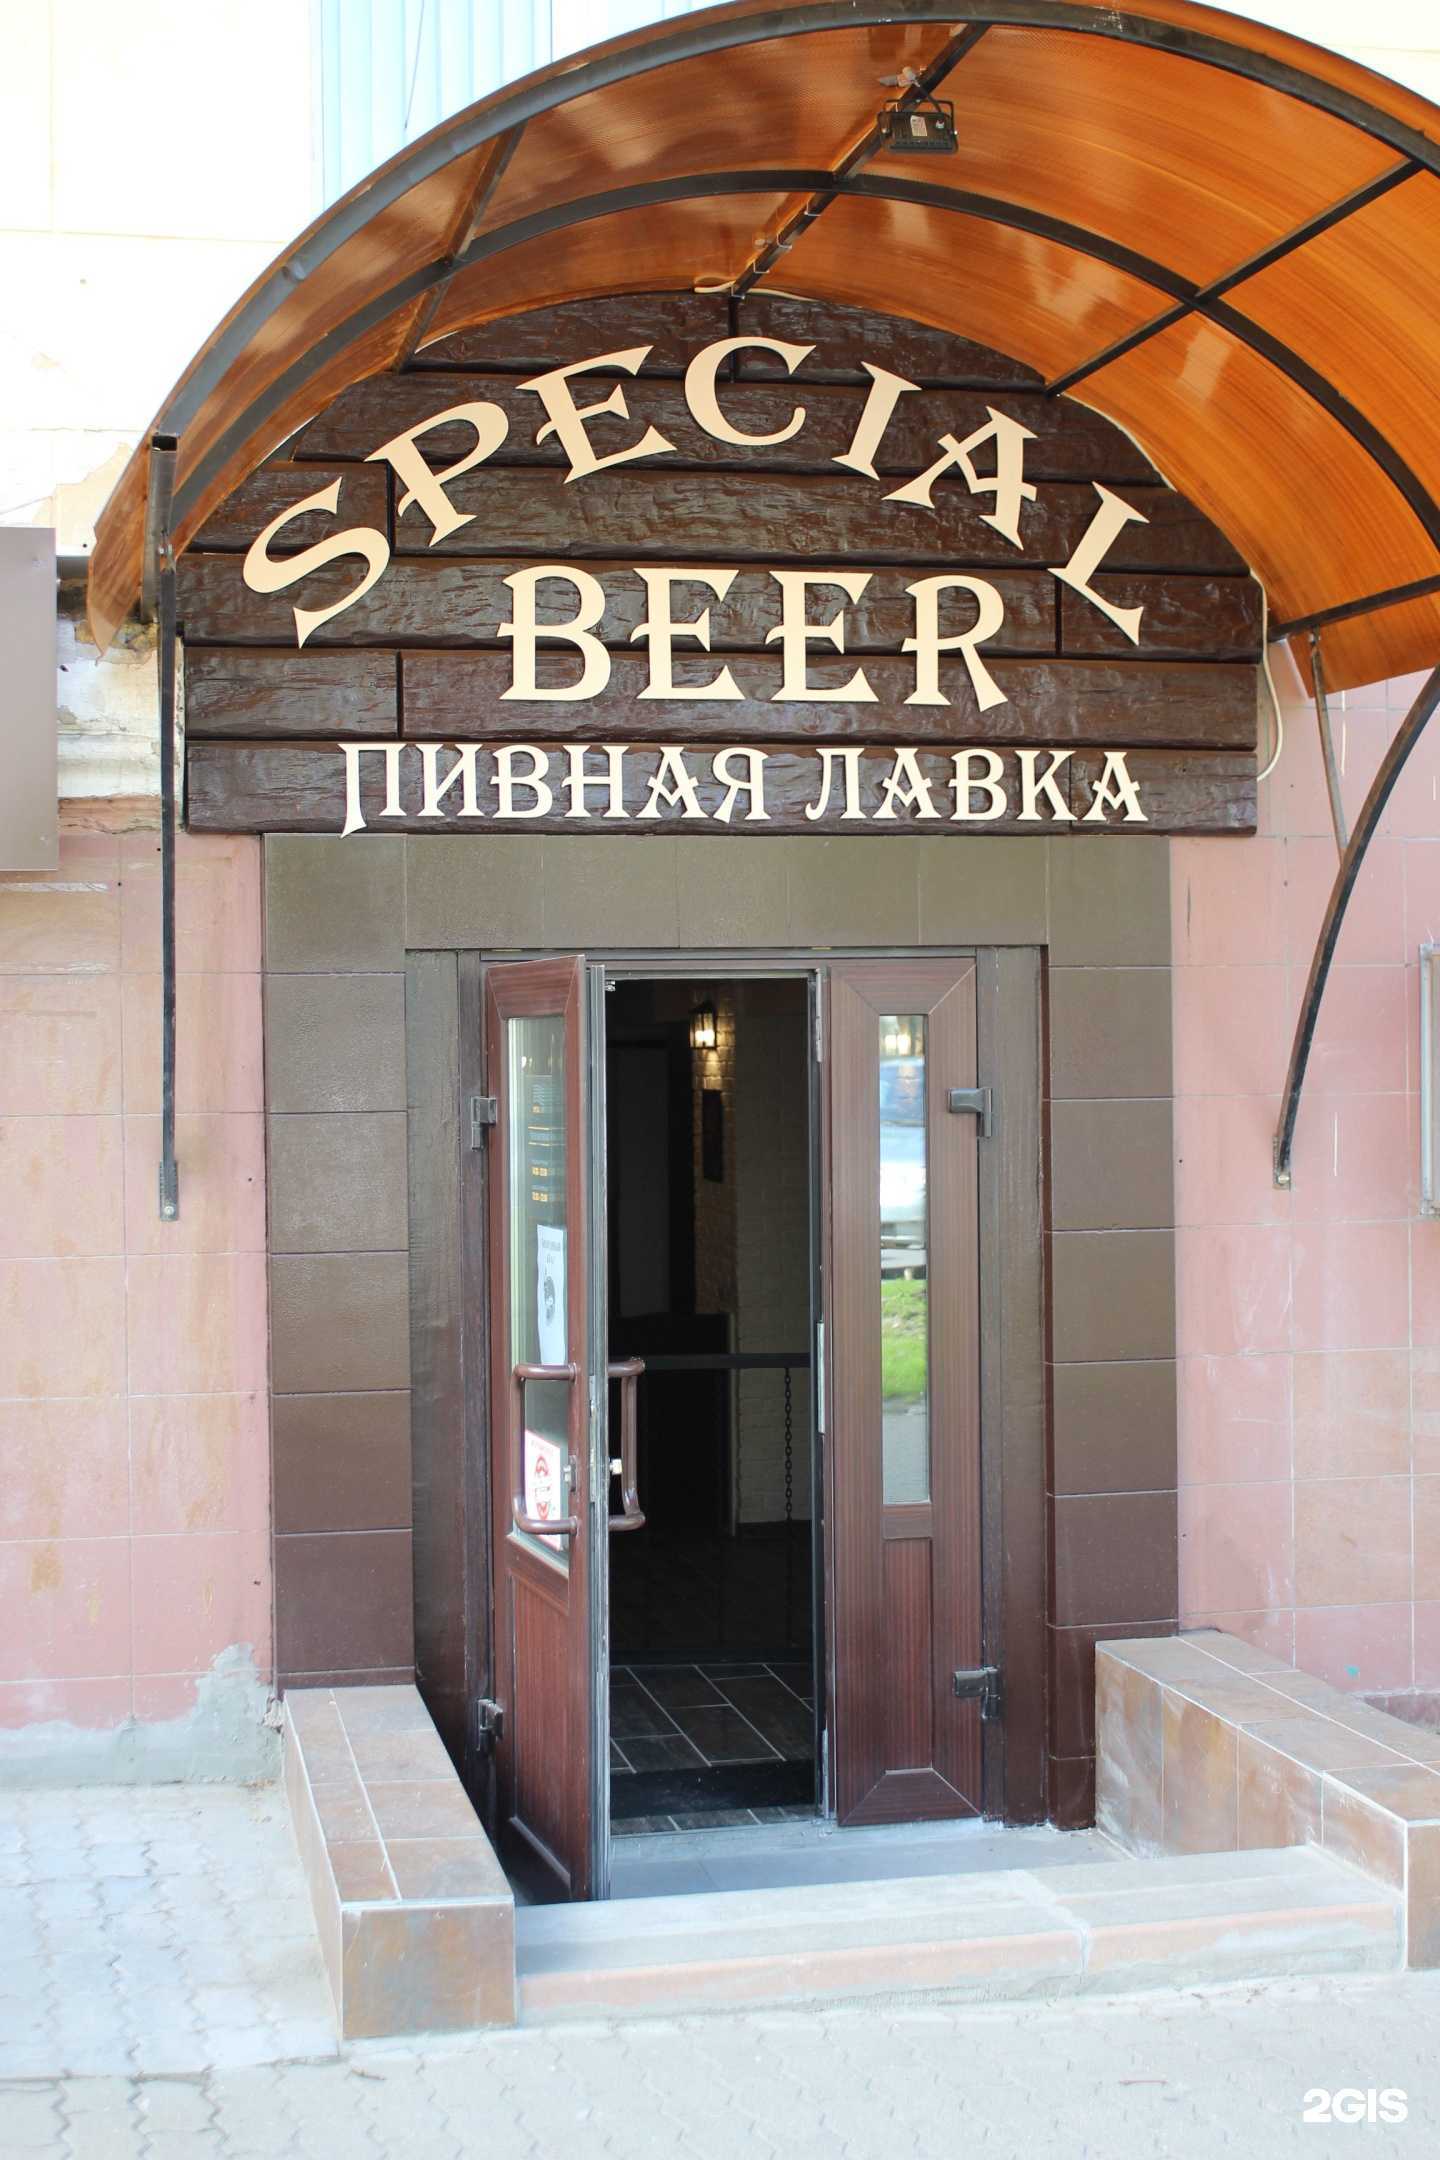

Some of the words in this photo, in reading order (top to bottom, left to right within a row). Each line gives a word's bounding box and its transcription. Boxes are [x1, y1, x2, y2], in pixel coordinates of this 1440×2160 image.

[242, 336, 1150, 648] SPECIAL
[497, 566, 1009, 711] BEER
[338, 743, 772, 839] ПИВНАЯ
[804, 747, 1149, 825] ЛАВКА
